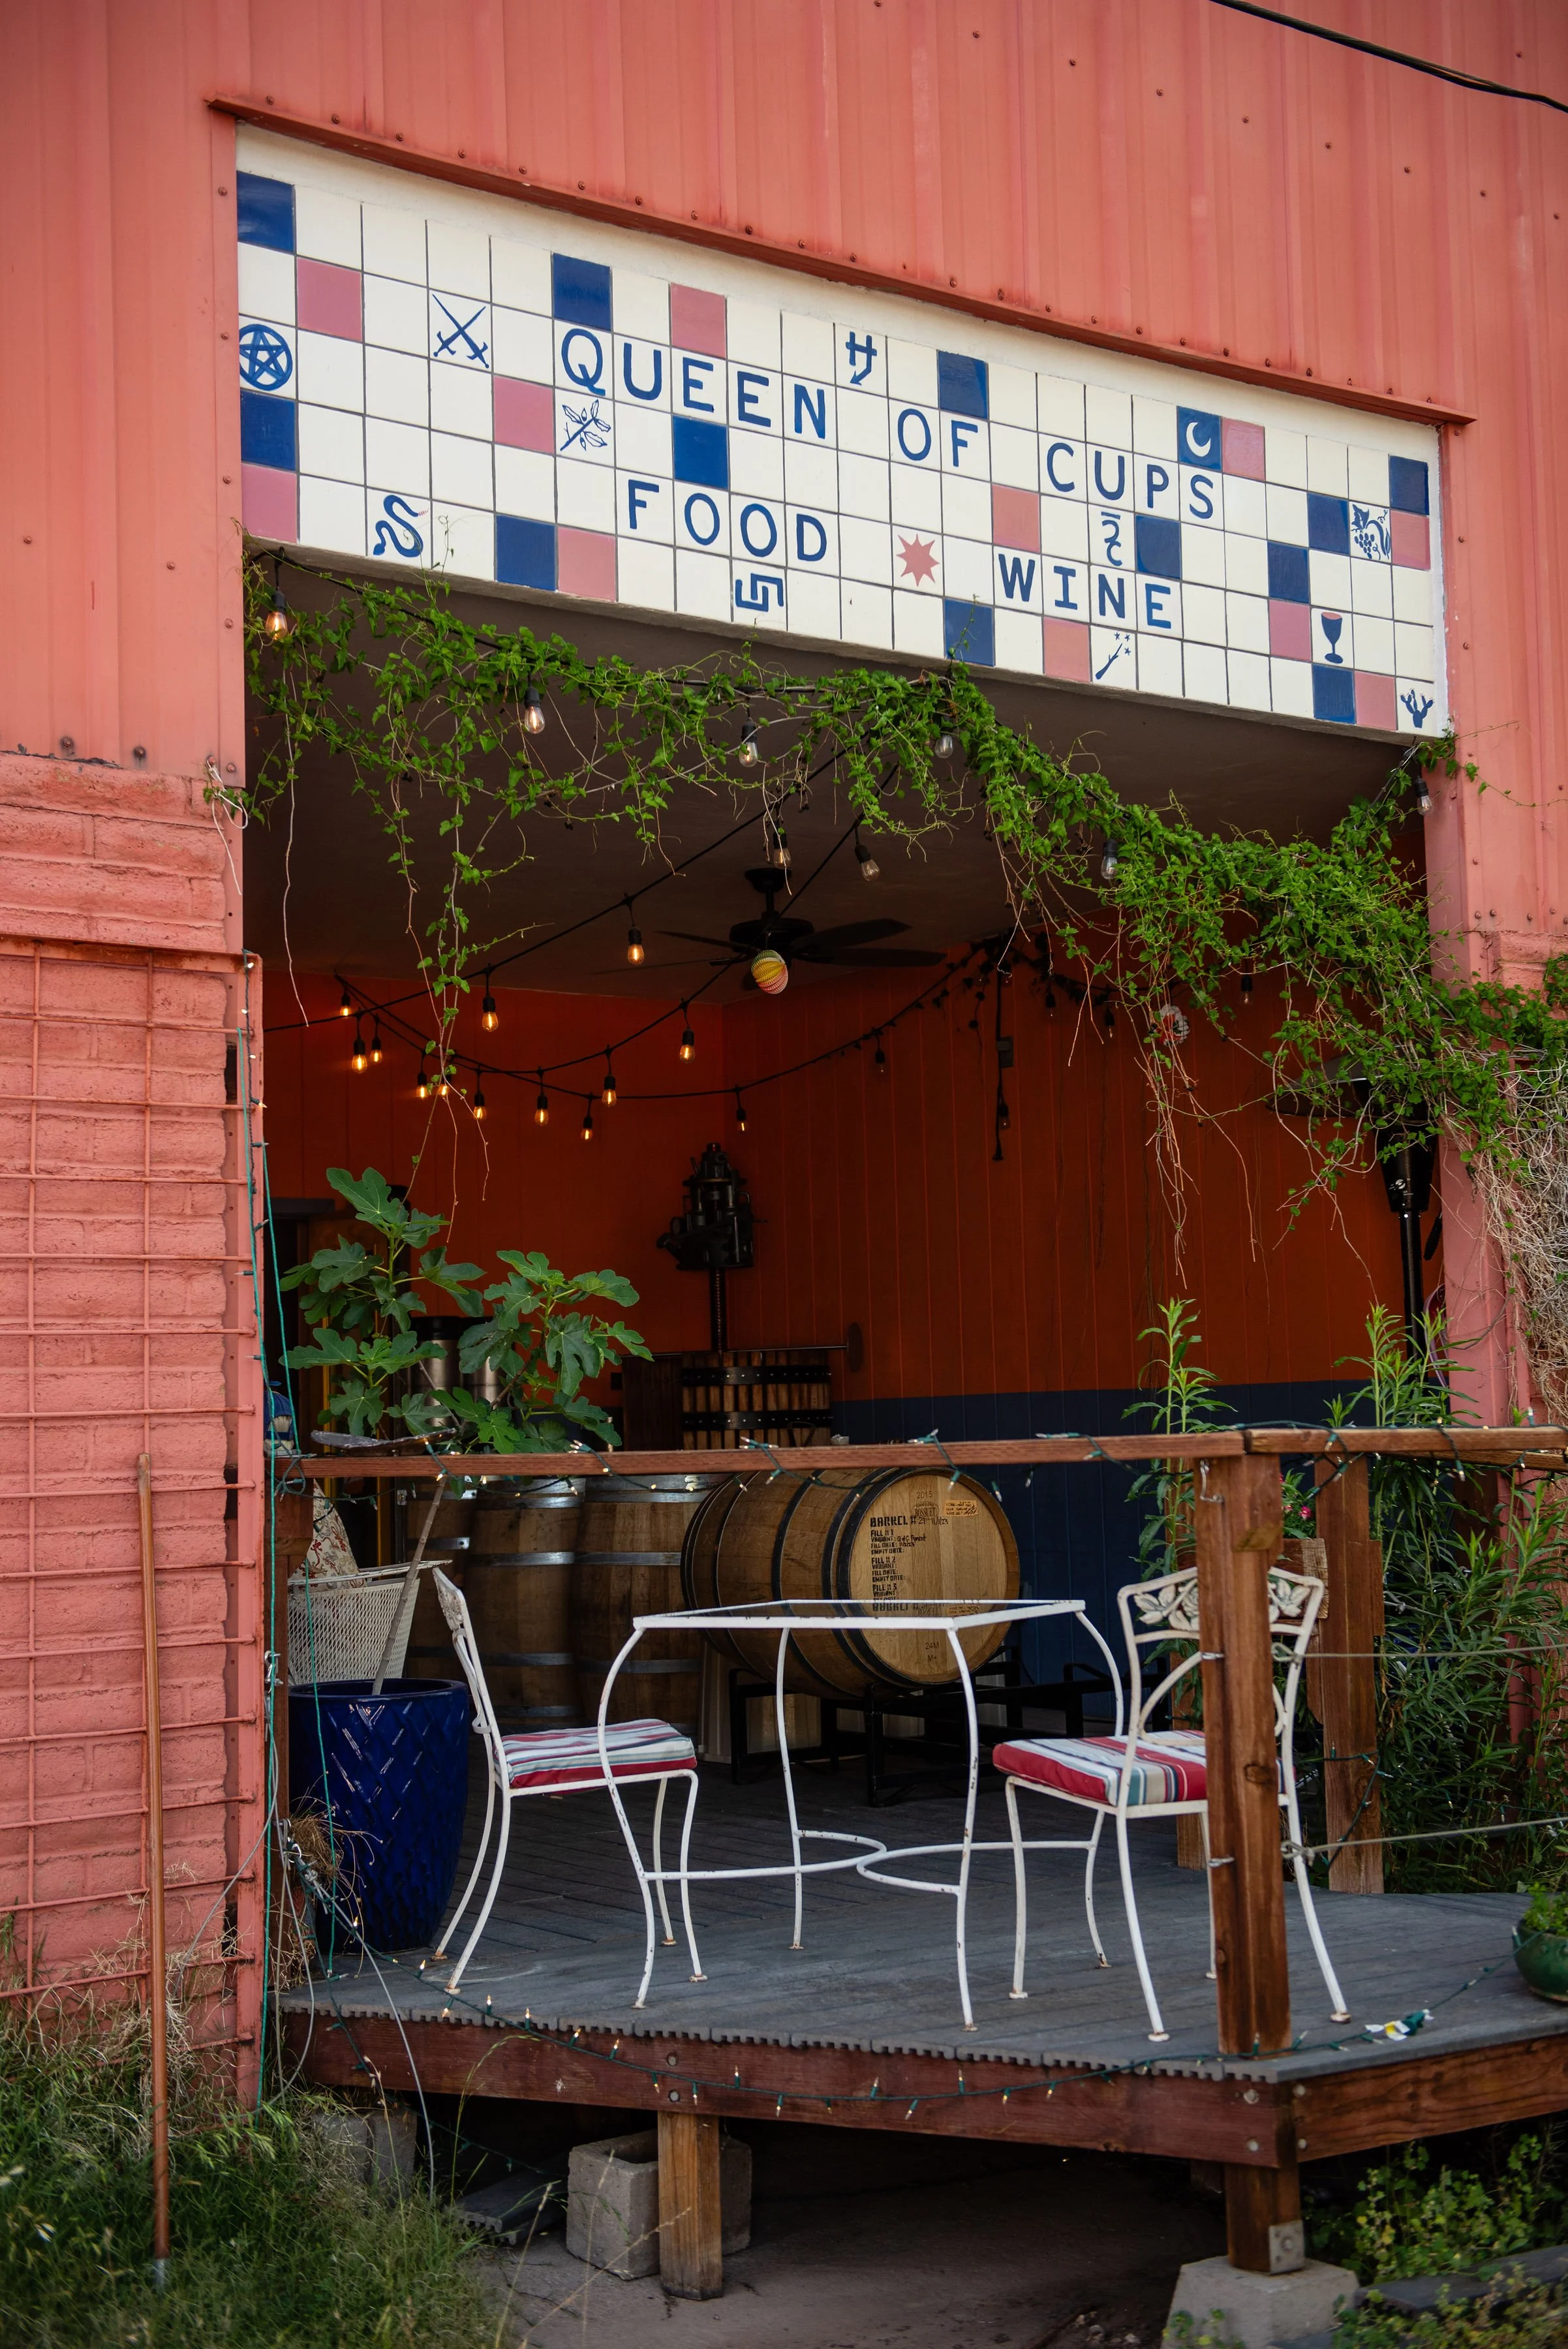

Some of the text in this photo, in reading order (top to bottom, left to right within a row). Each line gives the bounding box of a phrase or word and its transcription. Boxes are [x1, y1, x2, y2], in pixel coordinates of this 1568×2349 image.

[561, 328, 1213, 519] QUEEN OF CUPS
[628, 479, 1171, 629] FOOD WINE
[870, 1516, 908, 1527] BARREL
[917, 1490, 933, 1499] 2015
